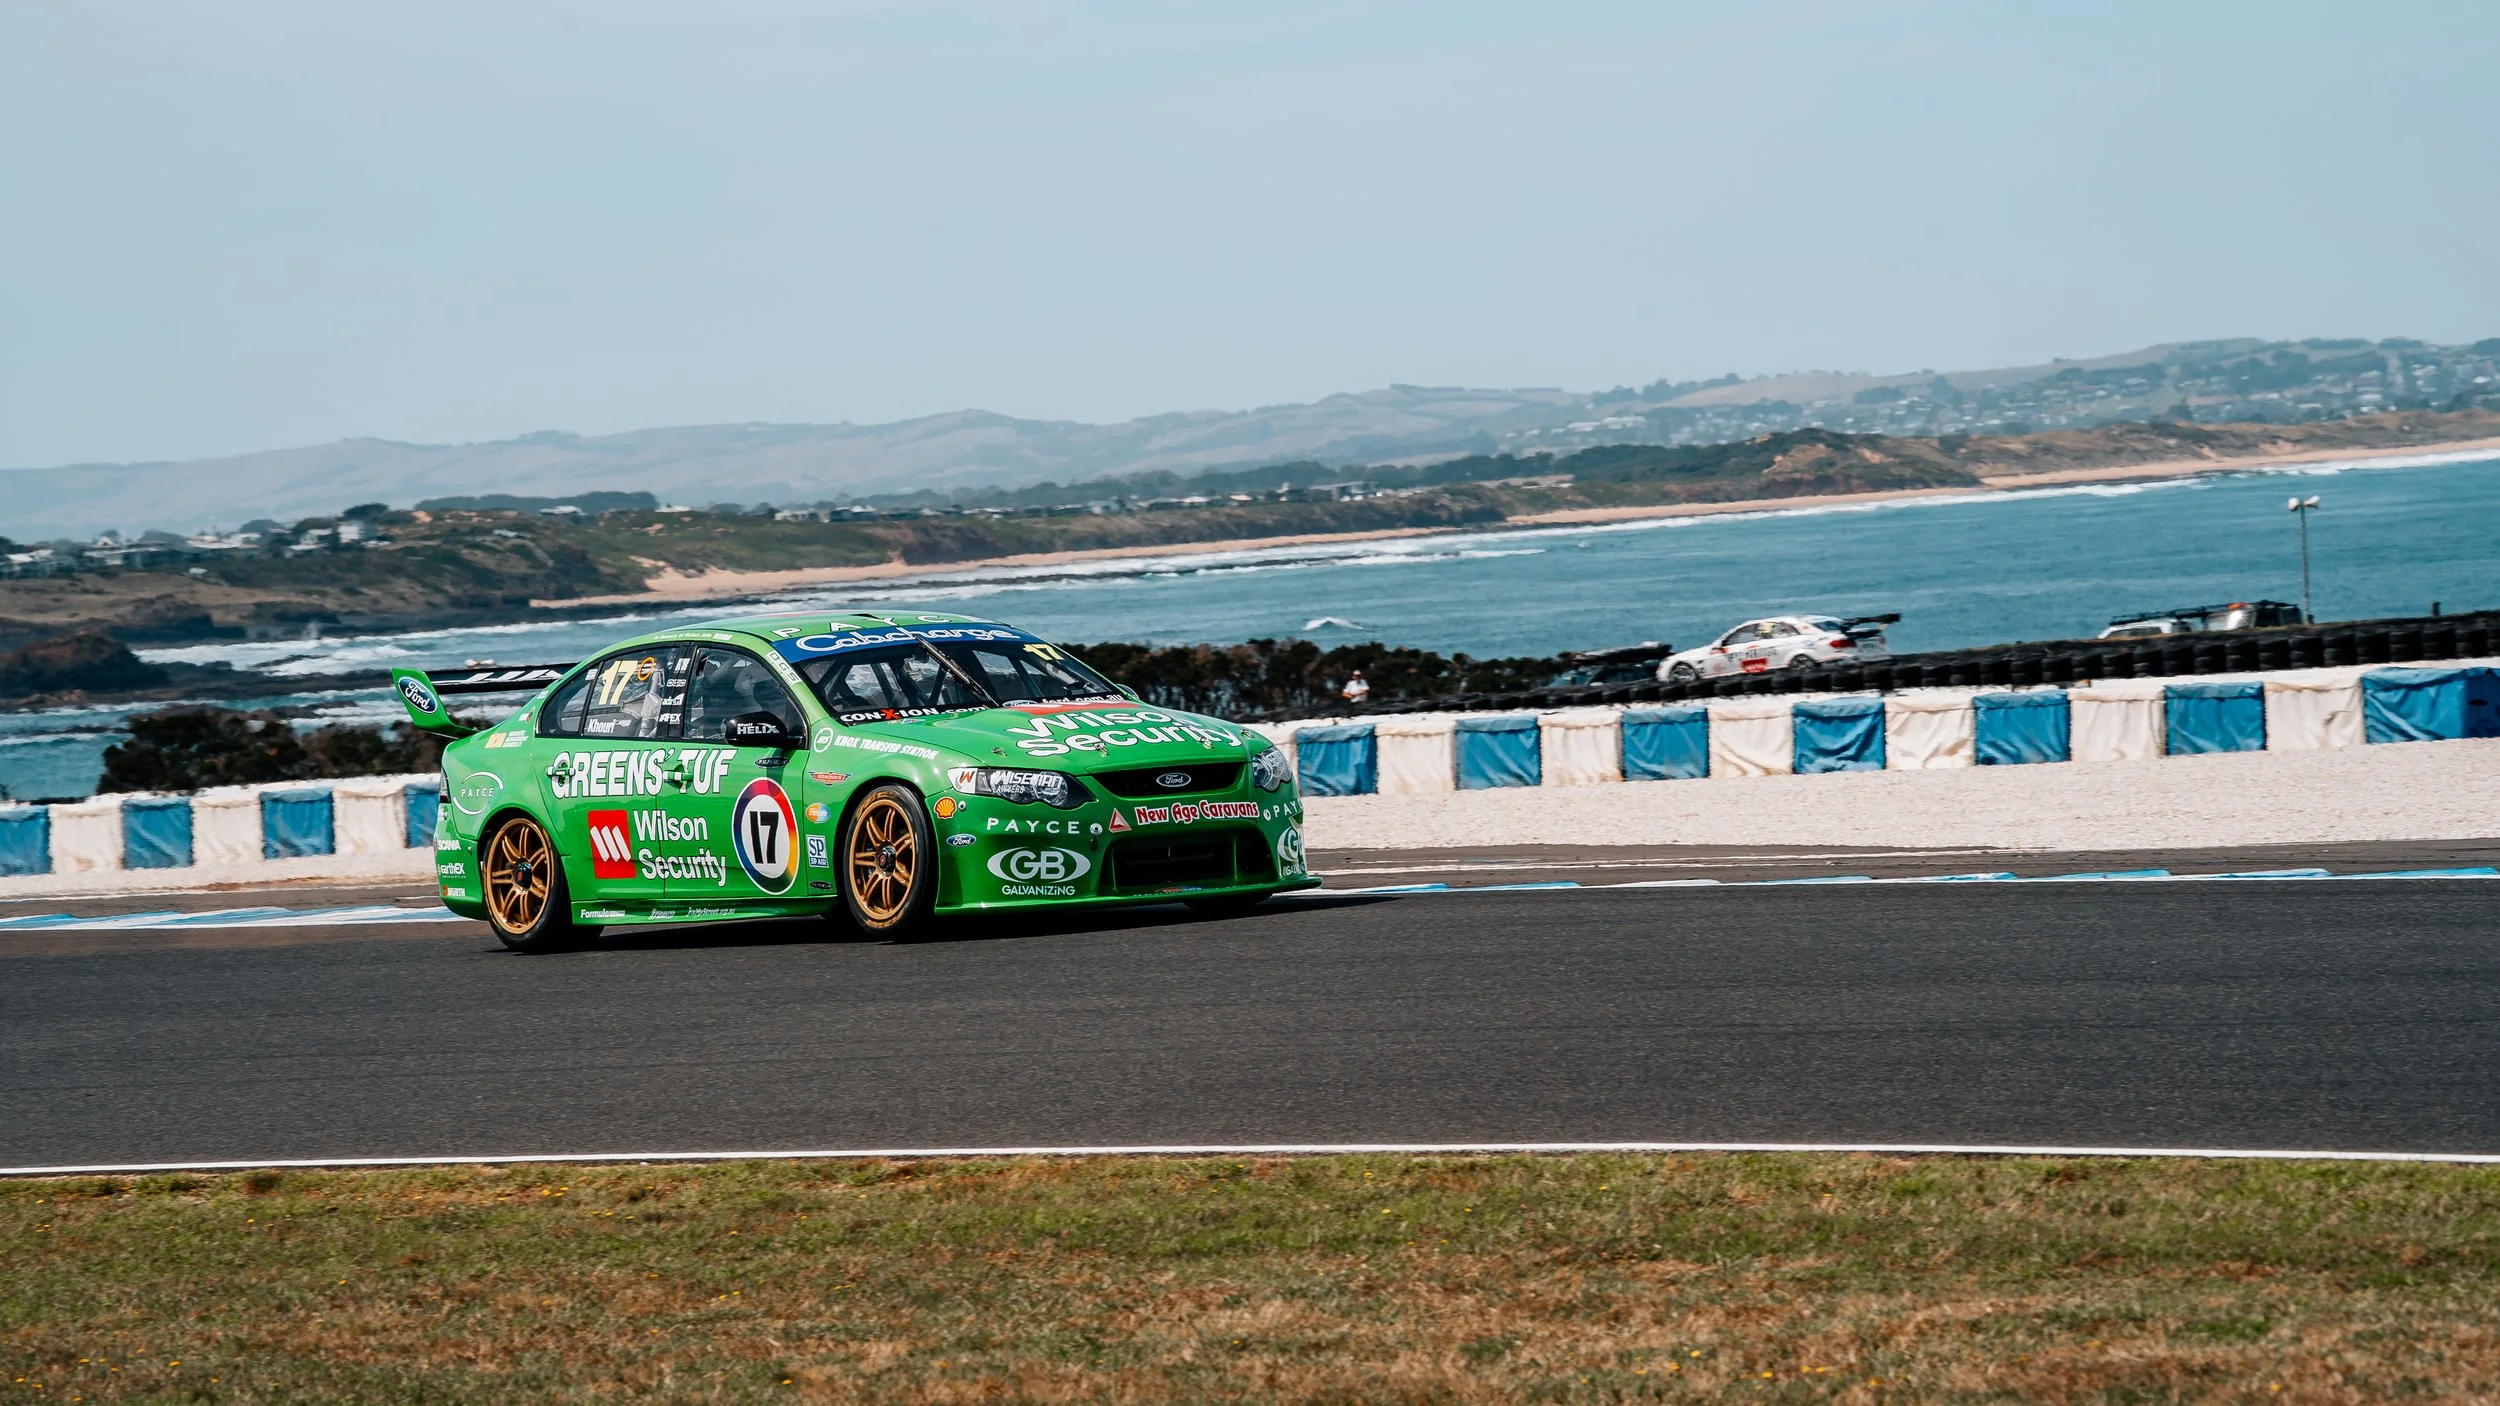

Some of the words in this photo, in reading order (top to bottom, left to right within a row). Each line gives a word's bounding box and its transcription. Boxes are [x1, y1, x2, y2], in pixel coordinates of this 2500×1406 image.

[796, 627, 1020, 652] Cabcharge
[1023, 644, 1064, 661] 17
[599, 660, 638, 705] 17
[404, 681, 430, 711] Ford
[737, 724, 779, 735] HELIX
[834, 735, 860, 748] KNOX
[860, 739, 901, 754] TRANSFER
[899, 744, 940, 760] STATION
[677, 748, 738, 795] TUF
[1165, 774, 1183, 784] Ford
[461, 788, 494, 798] PAYCE
[1135, 808, 1168, 824] New
[1172, 804, 1198, 822] Age
[1200, 801, 1258, 818] Caravans
[633, 810, 708, 842] Wilson
[749, 811, 779, 864] 17
[987, 818, 1080, 834] PAYCE
[437, 840, 461, 851] SCANIA
[809, 838, 824, 856] SP
[952, 835, 971, 845] Ford
[639, 848, 726, 887] Security
[1010, 851, 1065, 880] GB
